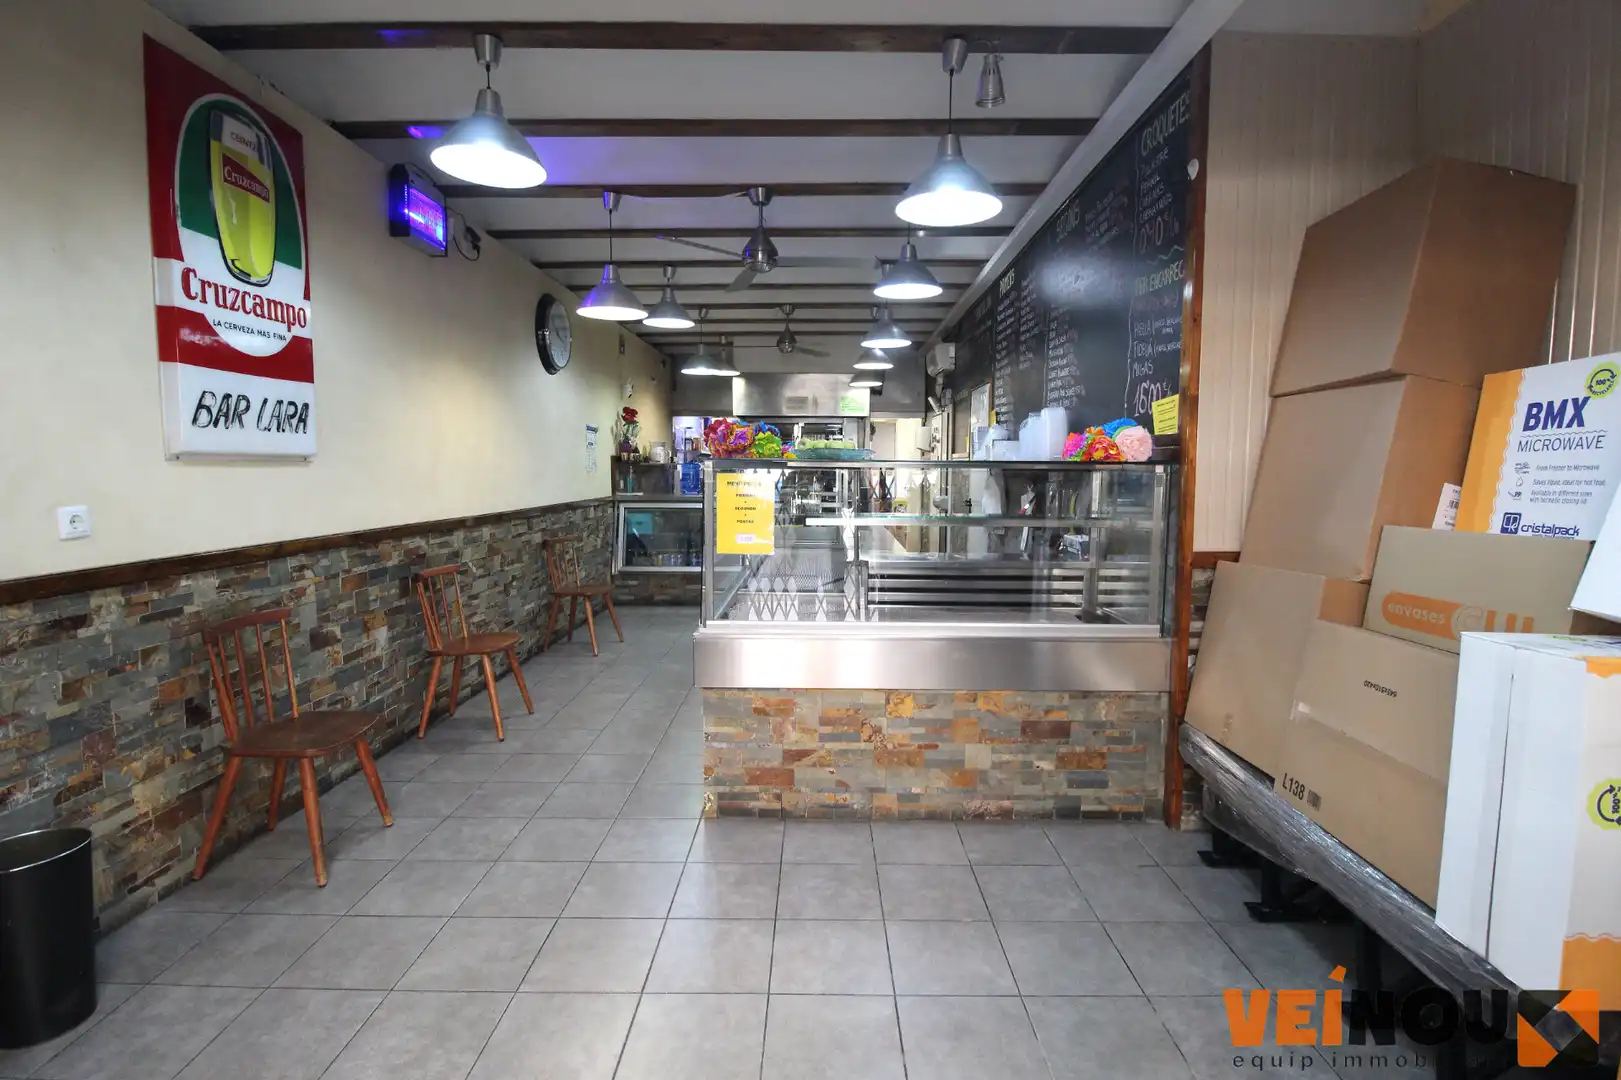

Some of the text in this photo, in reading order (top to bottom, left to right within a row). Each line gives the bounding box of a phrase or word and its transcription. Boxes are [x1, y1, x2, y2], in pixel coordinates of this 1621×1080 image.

[223, 163, 270, 201] Cruzcampo
[182, 267, 307, 332] Cruzcampo
[212, 318, 287, 342] LA CERVEZA MAS FINA
[191, 390, 310, 434] BAR LARA
[1522, 397, 1590, 432] BMX
[1517, 435, 1604, 452] MICROWAVE
[1521, 523, 1580, 538] cristalpack
[1387, 602, 1445, 625] envases
[1282, 772, 1305, 801] L138
